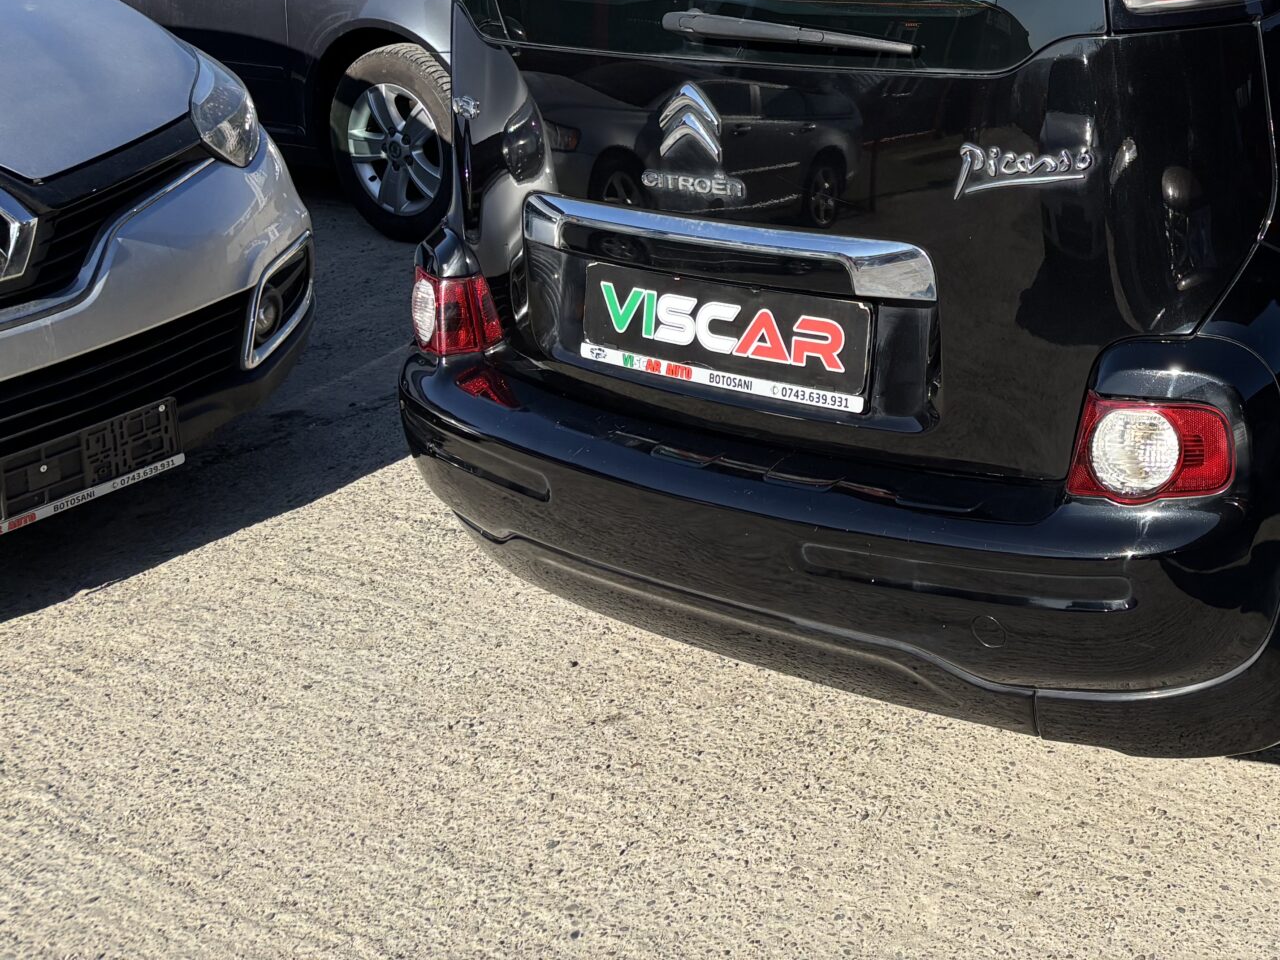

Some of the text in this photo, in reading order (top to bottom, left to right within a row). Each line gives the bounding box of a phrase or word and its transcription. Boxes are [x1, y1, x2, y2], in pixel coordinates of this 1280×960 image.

[954, 142, 1093, 200] Picasso
[599, 280, 846, 373] VISCAR
[622, 353, 850, 409] VISCAR AUTO BOTOSANI 0743.639.931
[53, 490, 96, 512] BOTOSANI
[120, 459, 176, 486] 0743.639.931
